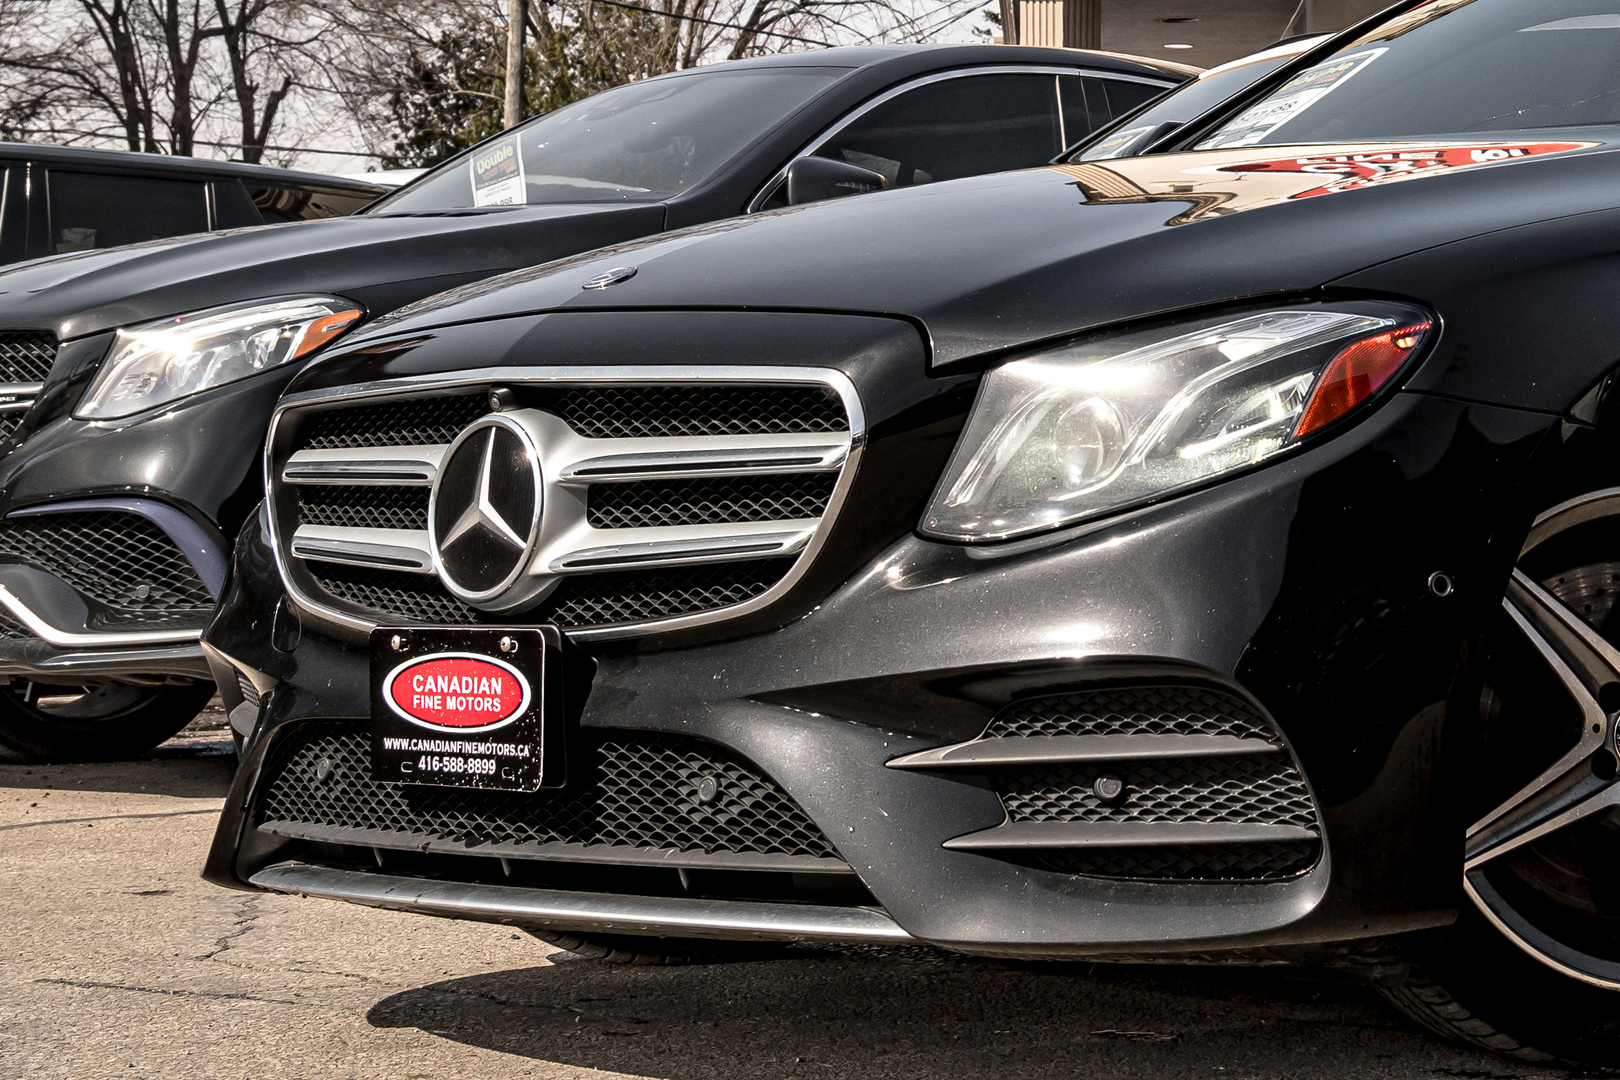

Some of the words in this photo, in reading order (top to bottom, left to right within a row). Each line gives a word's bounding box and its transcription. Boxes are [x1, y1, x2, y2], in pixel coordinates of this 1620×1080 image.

[476, 145, 514, 174] Double
[412, 674, 502, 695] CANADIAN
[412, 695, 442, 710] FINE
[446, 696, 501, 712] MOTORS
[383, 737, 530, 757] WWW.CANADIANFINEMOTORS.CA
[418, 755, 496, 775] 416-588-8899
